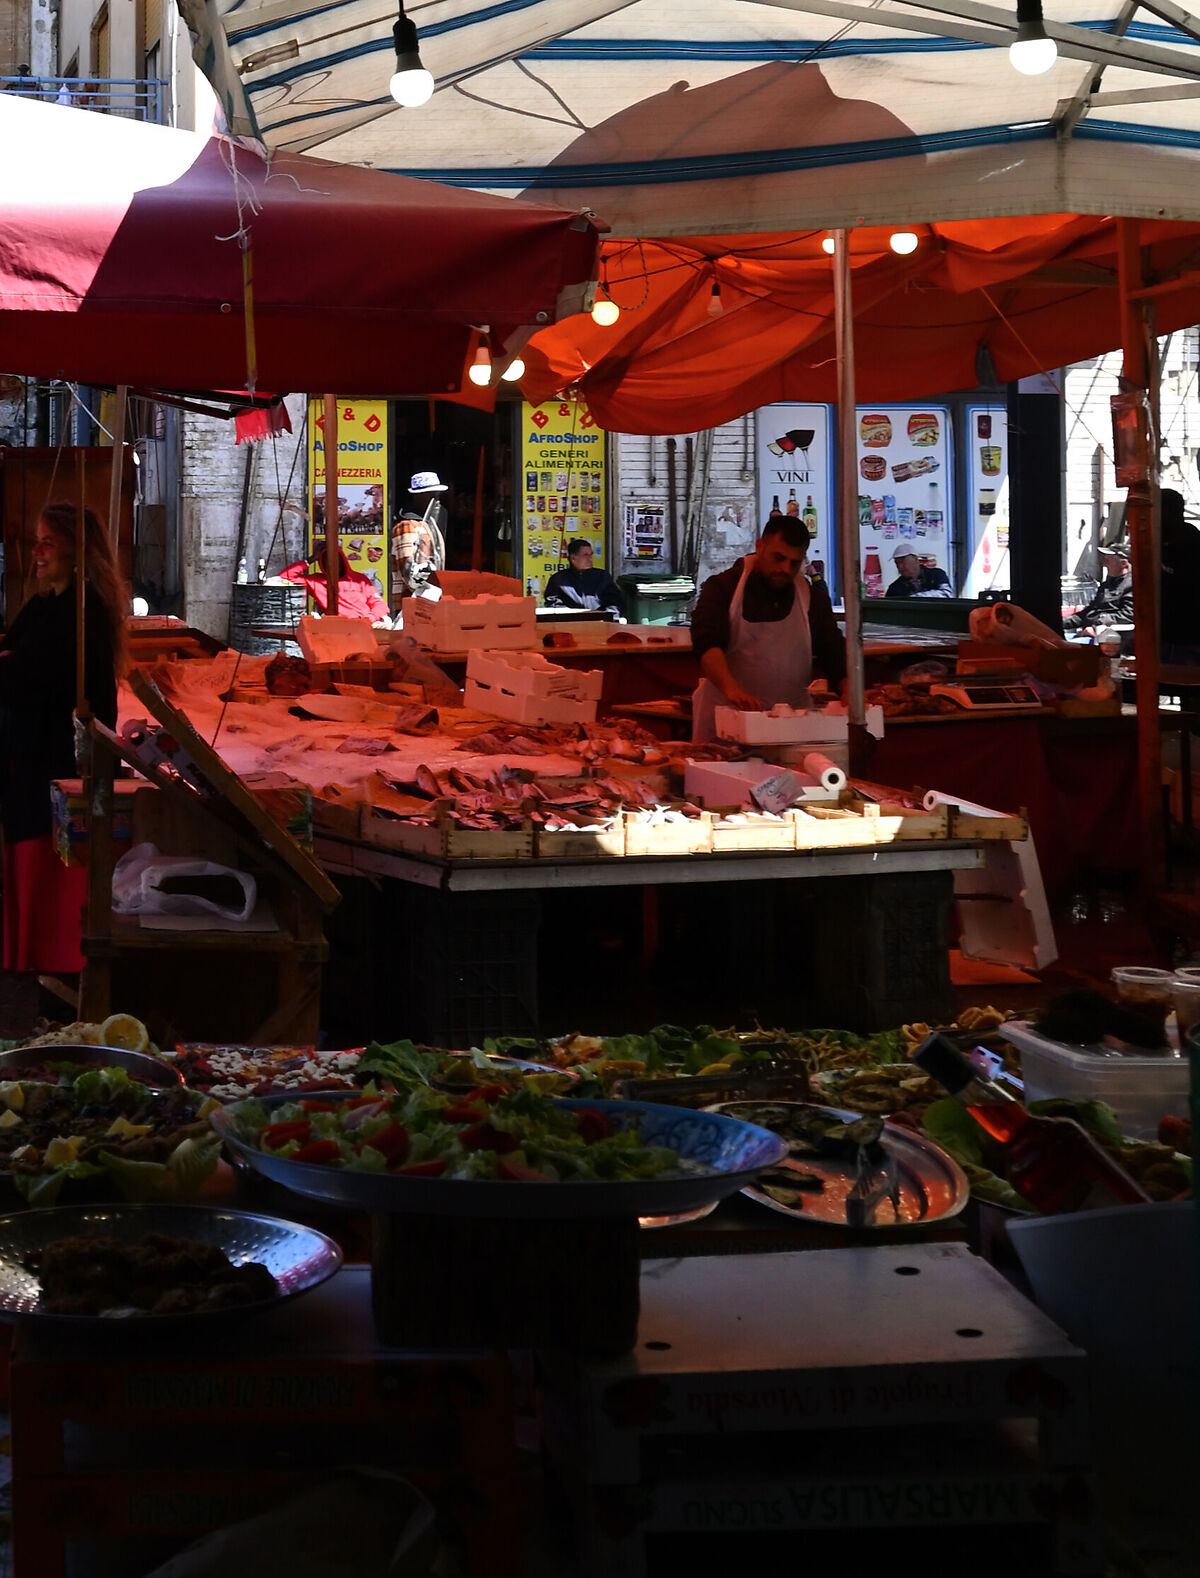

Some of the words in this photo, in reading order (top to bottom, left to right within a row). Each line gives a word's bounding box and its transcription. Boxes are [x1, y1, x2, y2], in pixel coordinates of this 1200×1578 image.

[540, 450, 588, 458] GENERI
[777, 471, 809, 482] VINI
[788, 1484, 1020, 1523] MARSALISA
